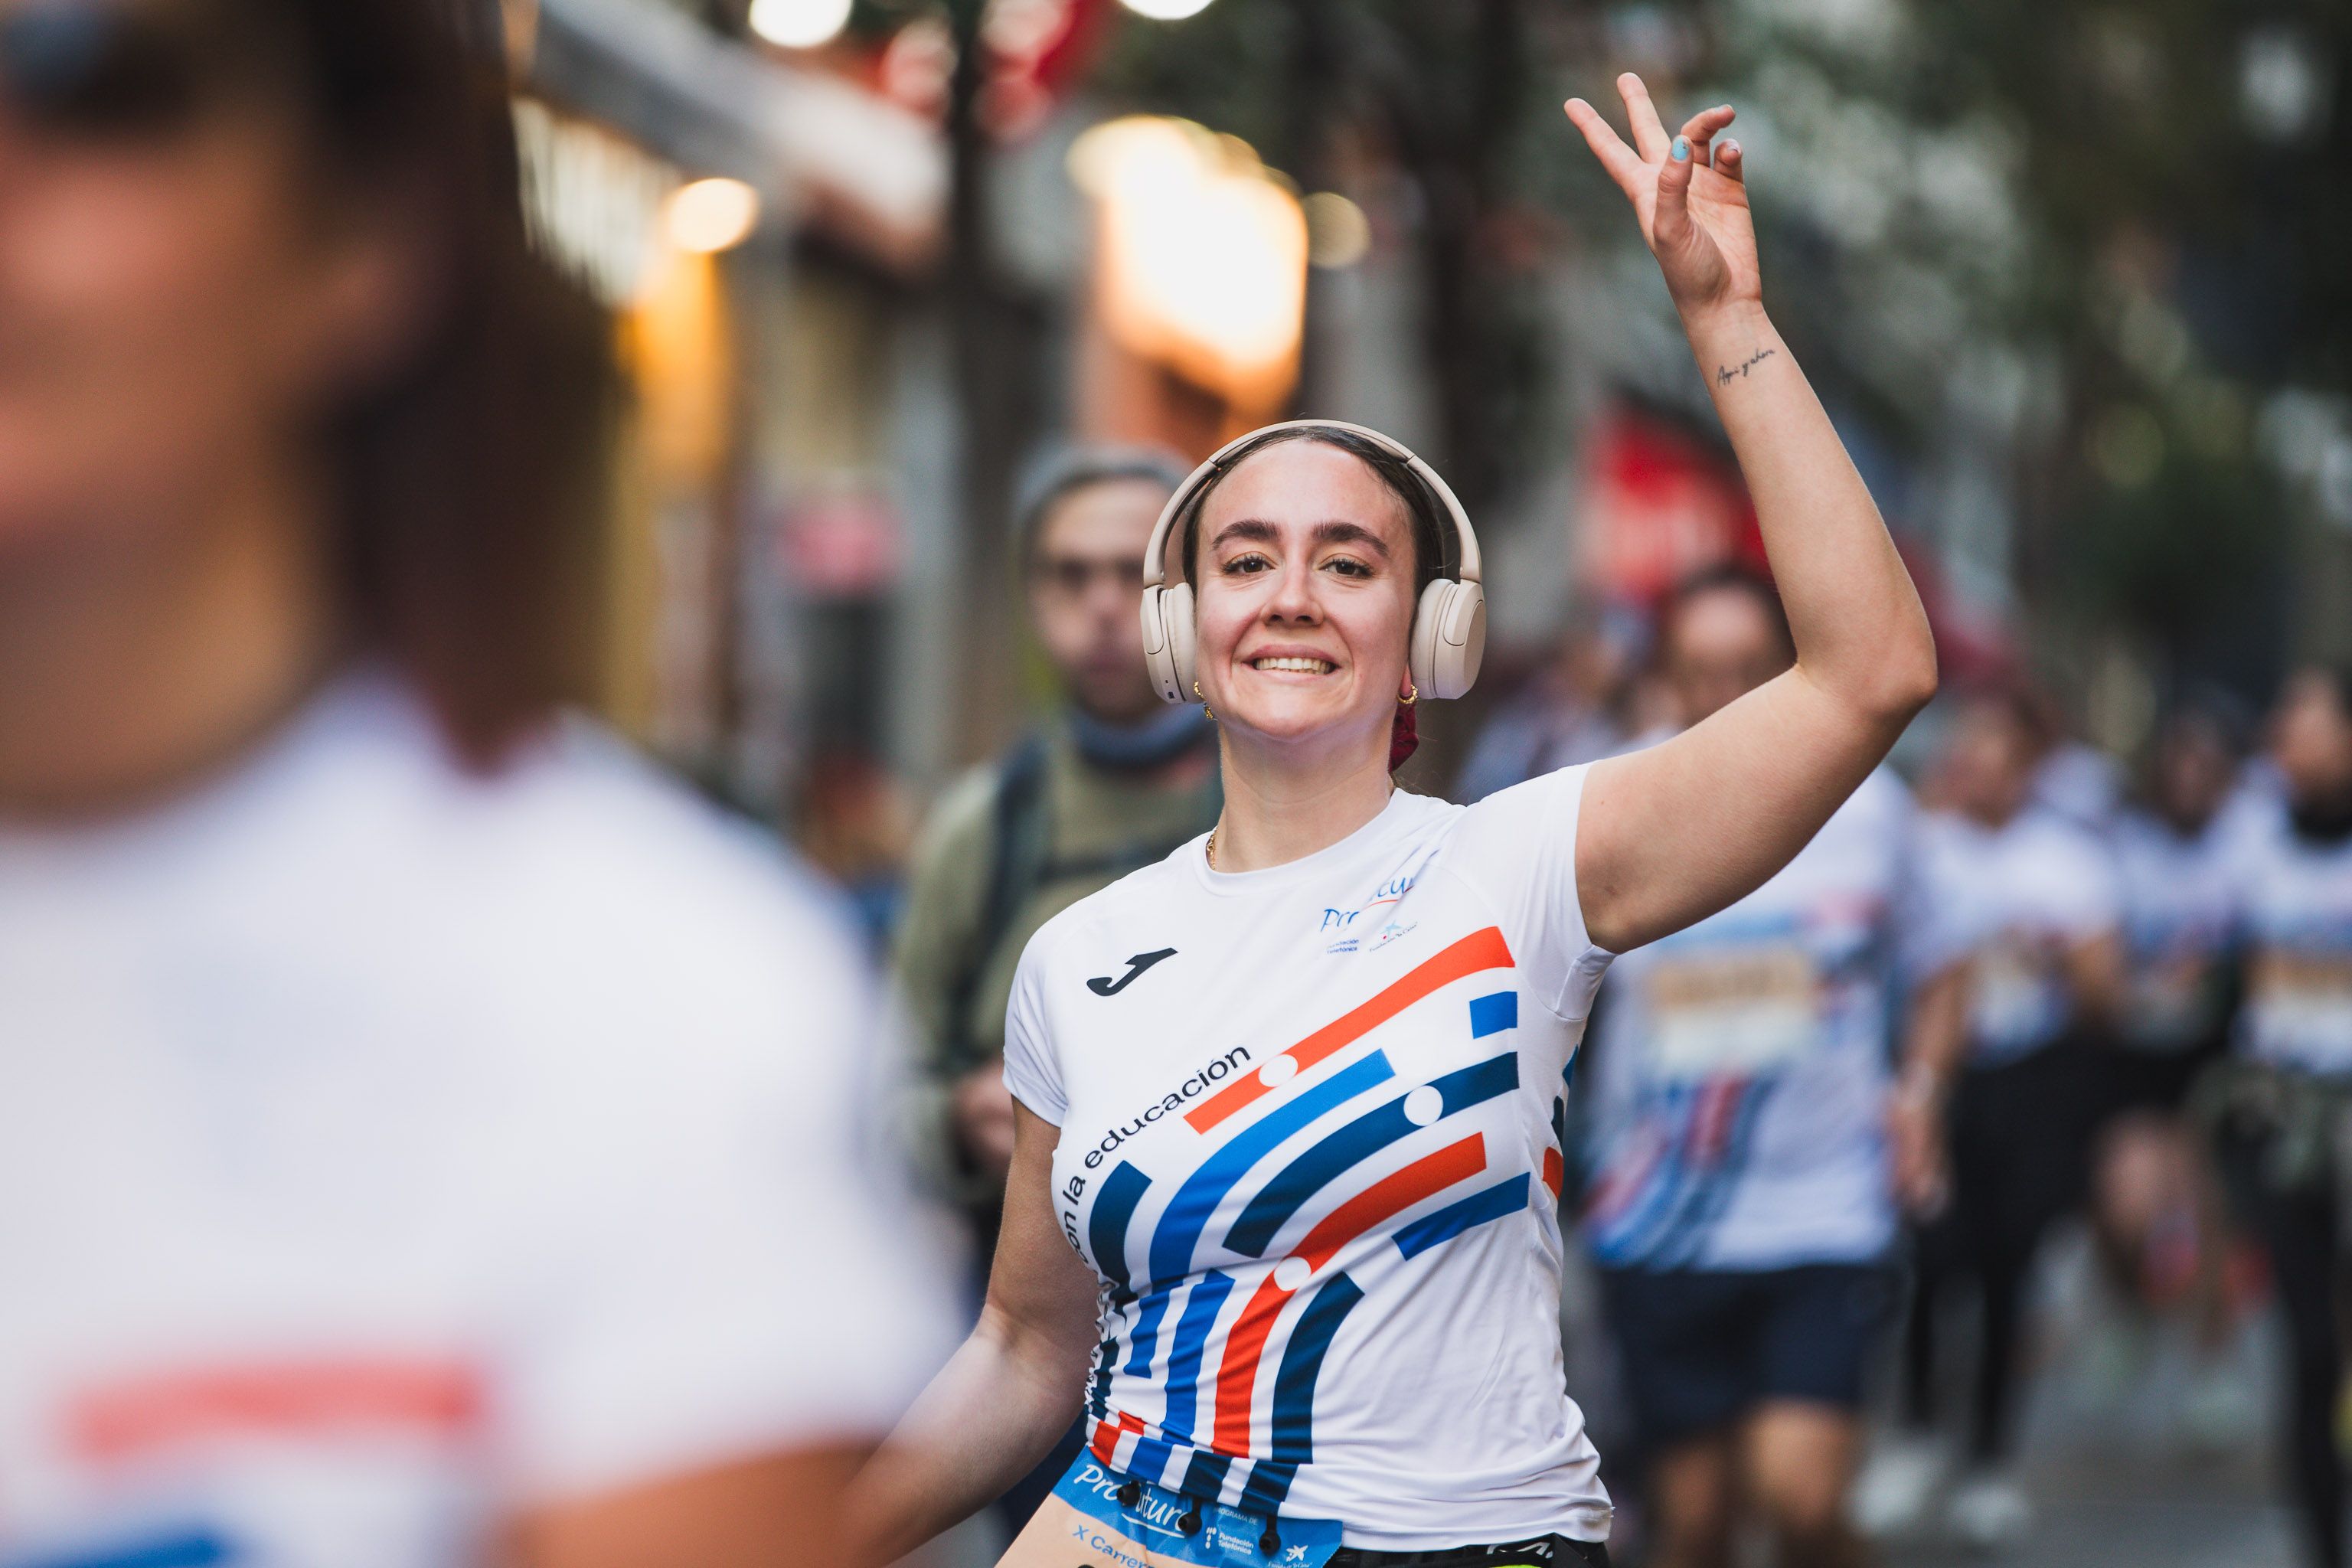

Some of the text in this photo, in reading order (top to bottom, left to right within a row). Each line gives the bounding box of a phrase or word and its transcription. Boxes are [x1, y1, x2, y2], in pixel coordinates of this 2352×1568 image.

[1063, 1175, 1086, 1206] la
[1084, 1046, 1251, 1169] educación
[1073, 1464, 1190, 1532] Proutur
[1073, 1524, 1089, 1541] X
